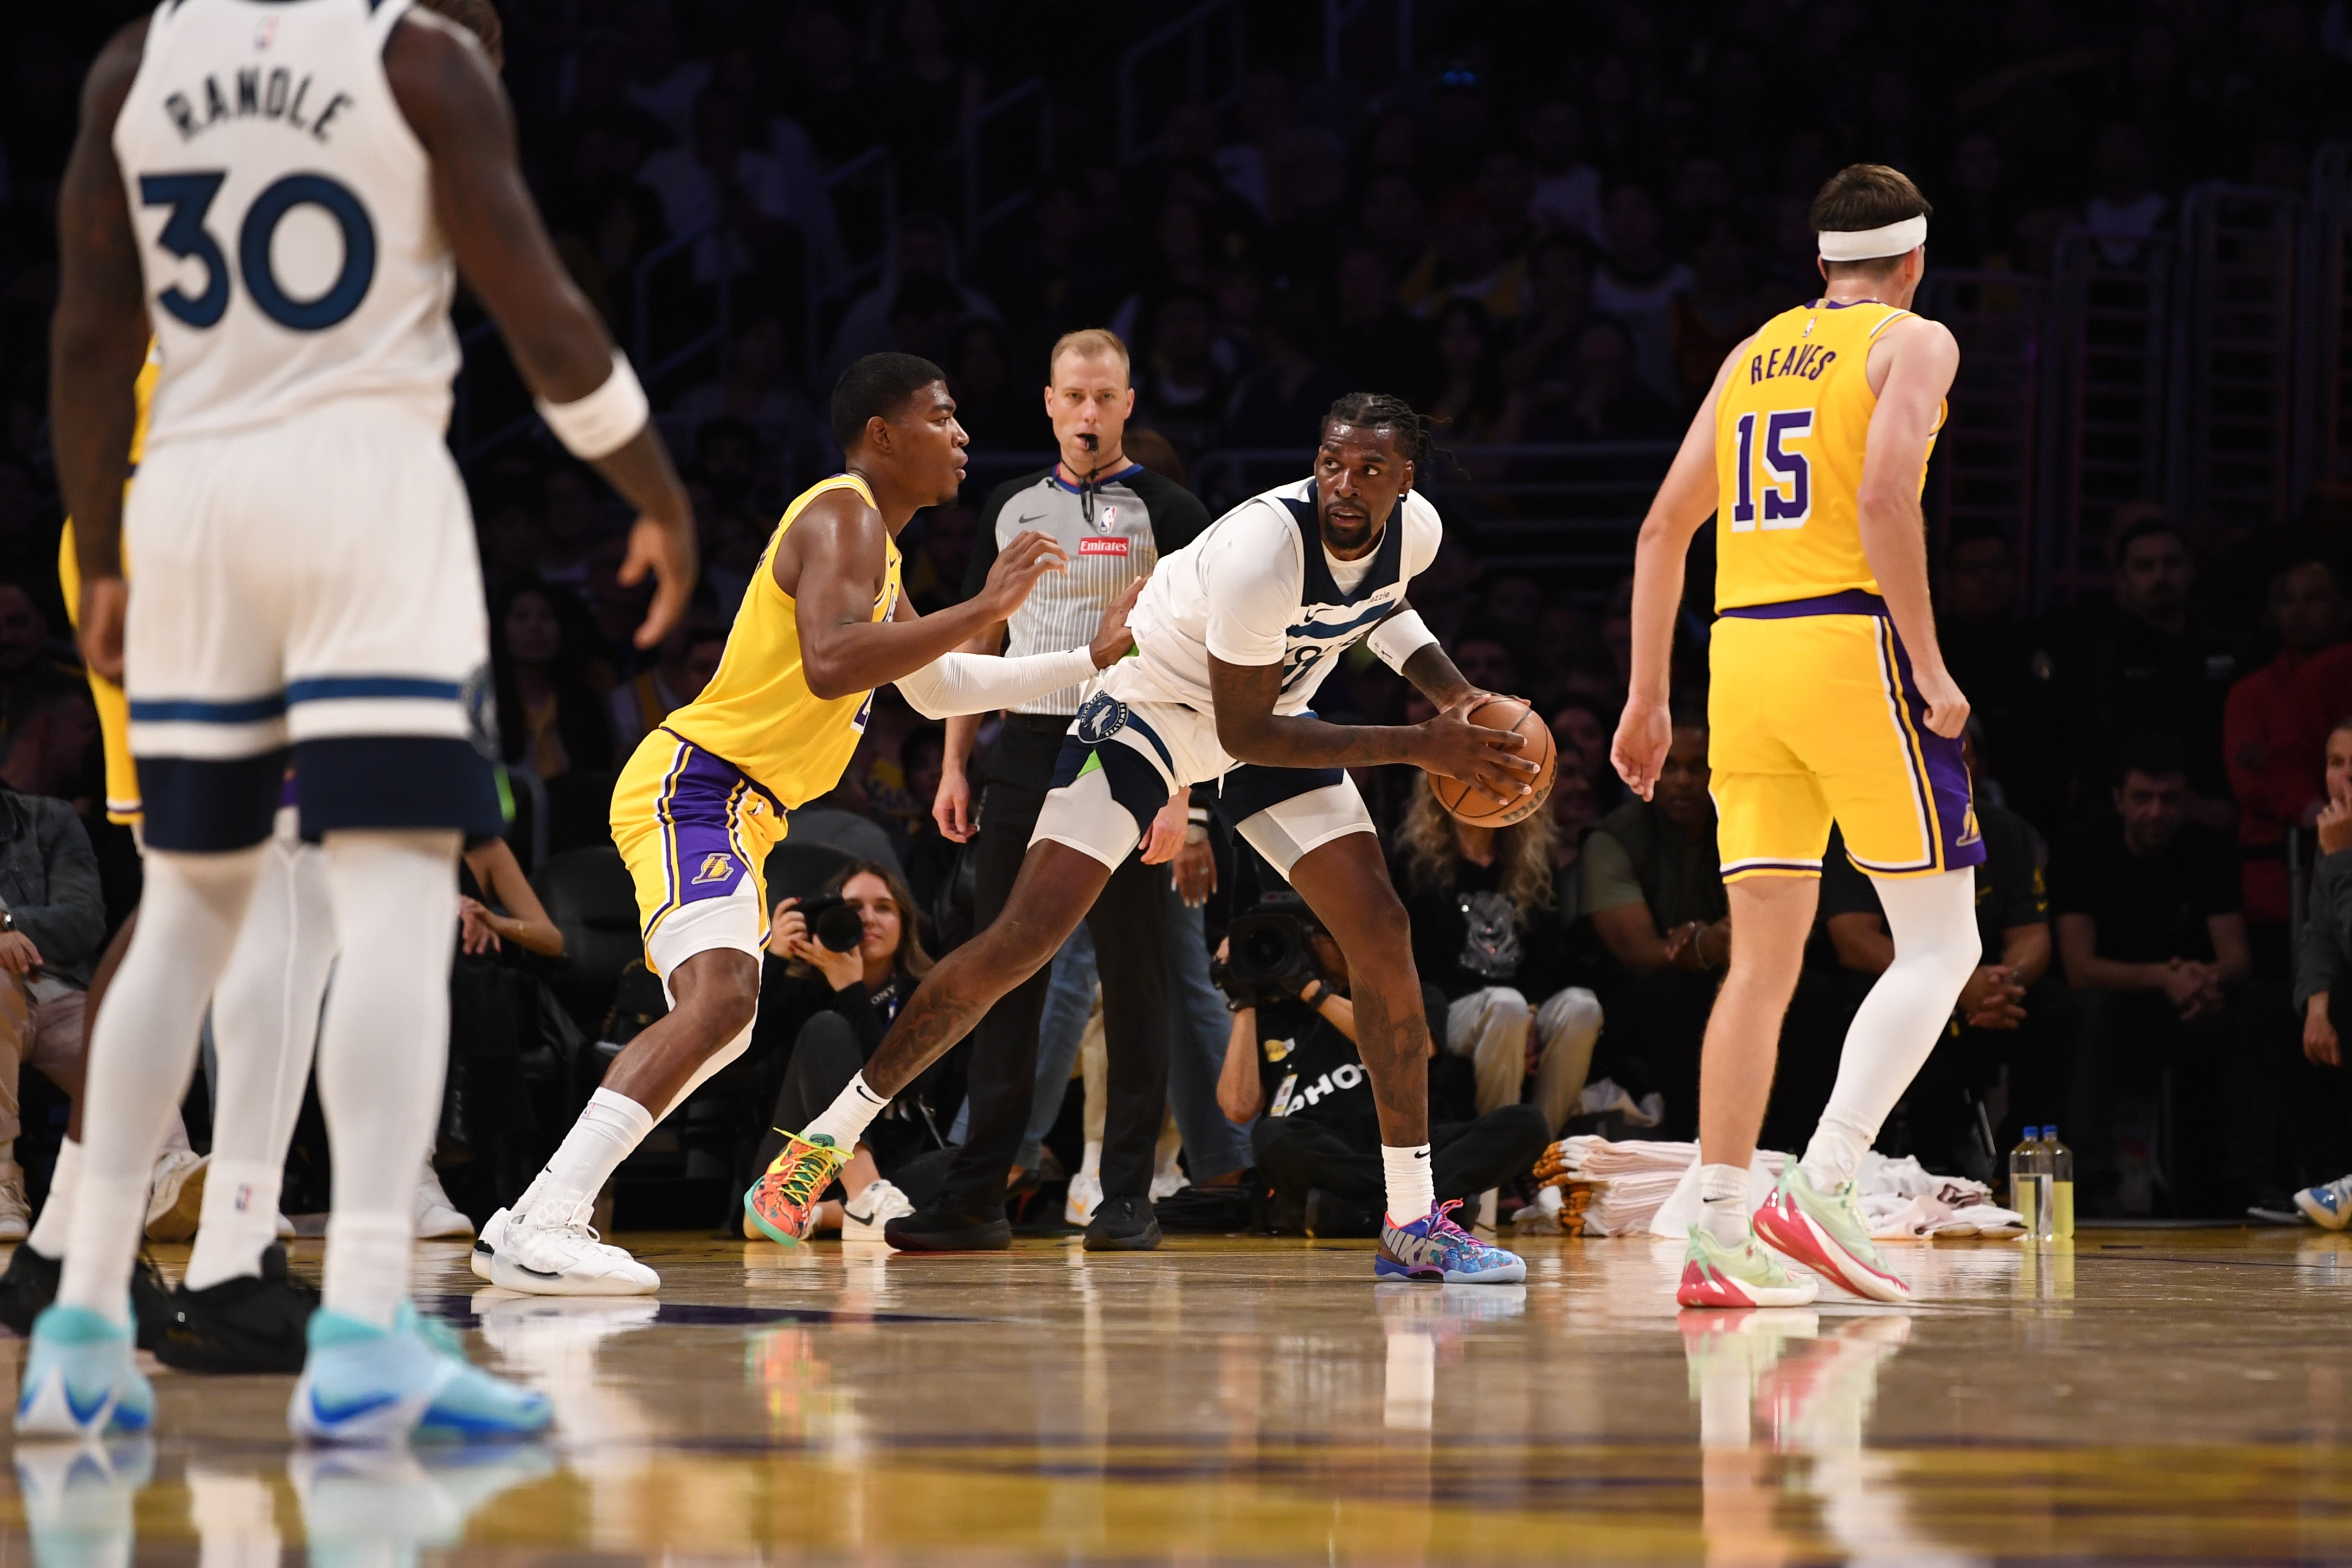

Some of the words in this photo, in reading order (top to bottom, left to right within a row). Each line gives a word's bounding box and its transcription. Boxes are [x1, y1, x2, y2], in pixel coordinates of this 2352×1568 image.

[165, 63, 355, 143] RANDLE
[138, 170, 376, 331] 30
[1751, 344, 1836, 385] REAVES
[1732, 407, 1815, 532] 15
[1080, 540, 1127, 552] Emirates
[1081, 690, 1104, 723] MINNESOT
[1105, 704, 1126, 737] ERWOLVES
[1284, 1064, 1366, 1117] PHO
